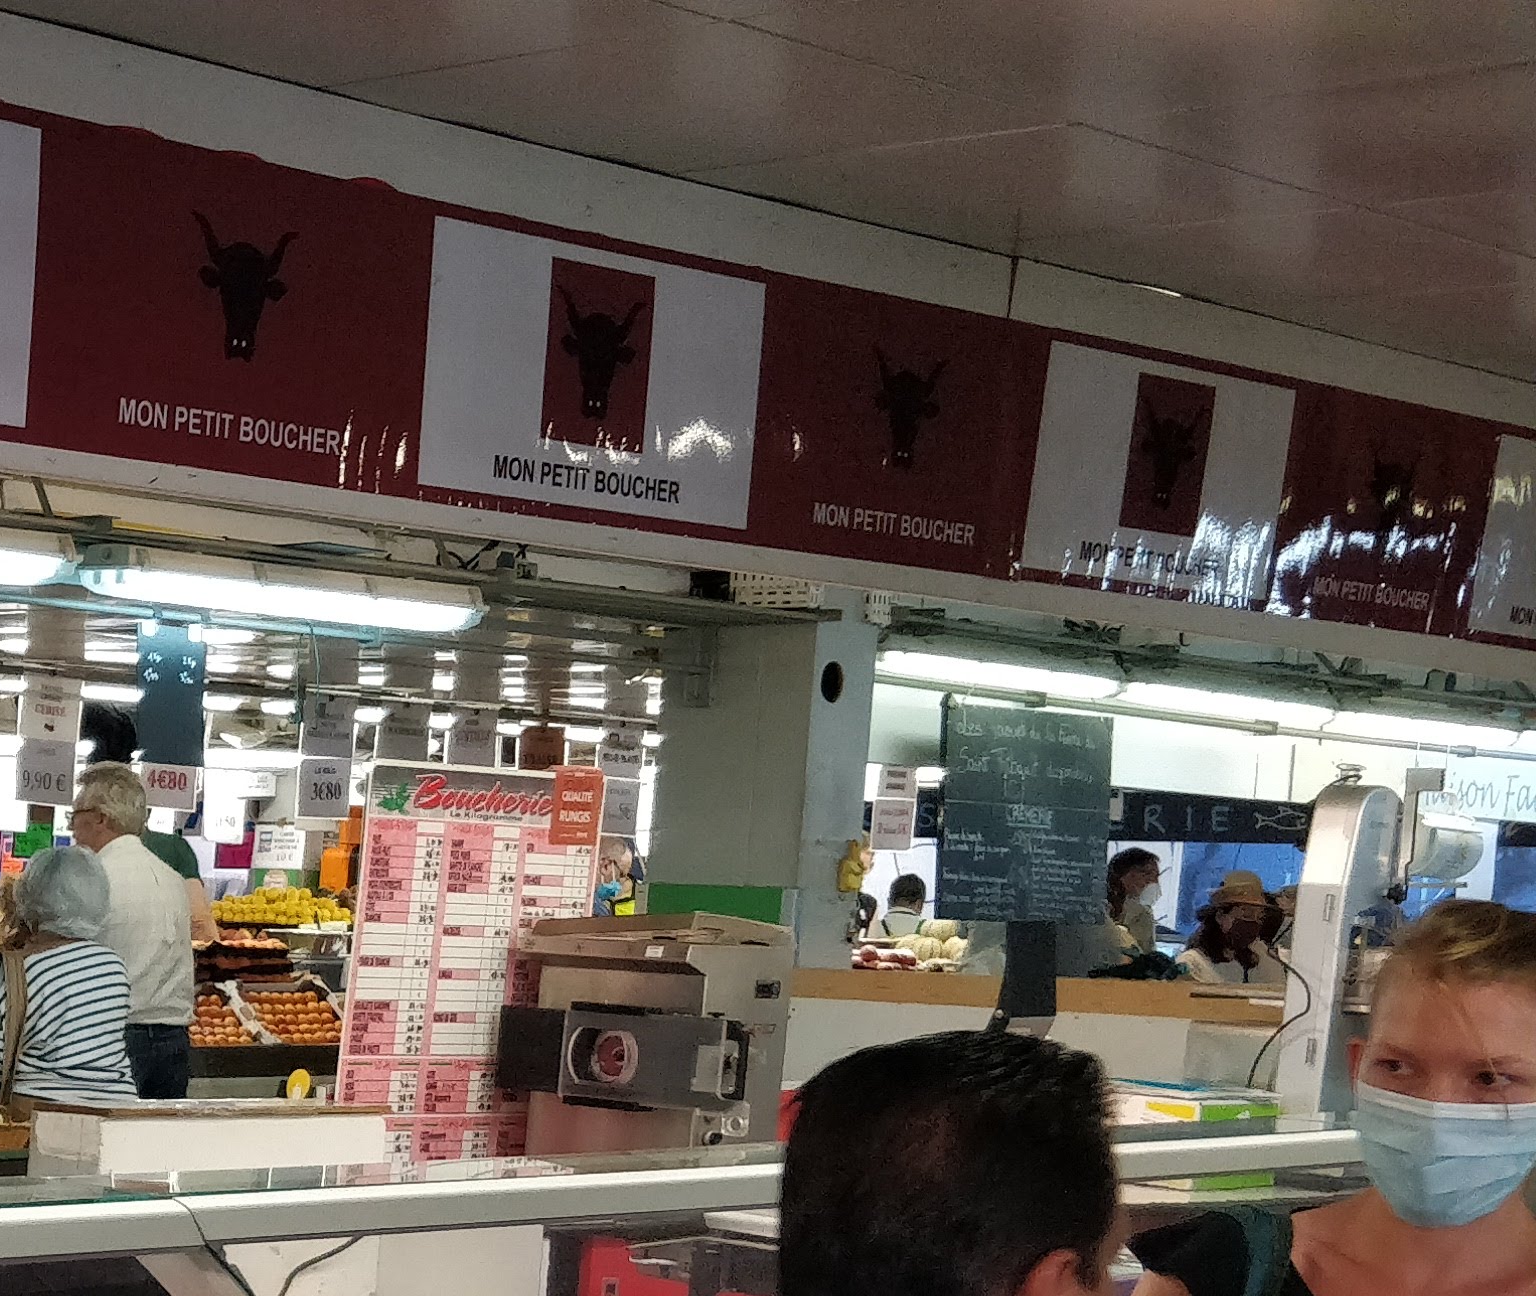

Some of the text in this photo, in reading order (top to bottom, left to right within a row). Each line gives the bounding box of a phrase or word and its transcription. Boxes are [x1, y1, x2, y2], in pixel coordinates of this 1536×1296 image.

[119, 397, 341, 457] MON PETIT BOUCHER
[493, 455, 680, 504] MON PETIT BOUCHER
[814, 502, 975, 545] MON PETIT BOUCHER
[1314, 576, 1430, 612] MON PETIT BOUCHER
[146, 769, 188, 791] 4€80
[413, 773, 555, 817] Boucherie
[449, 810, 524, 823] Le Kilogramme
[558, 809, 592, 824] RUNGIS
